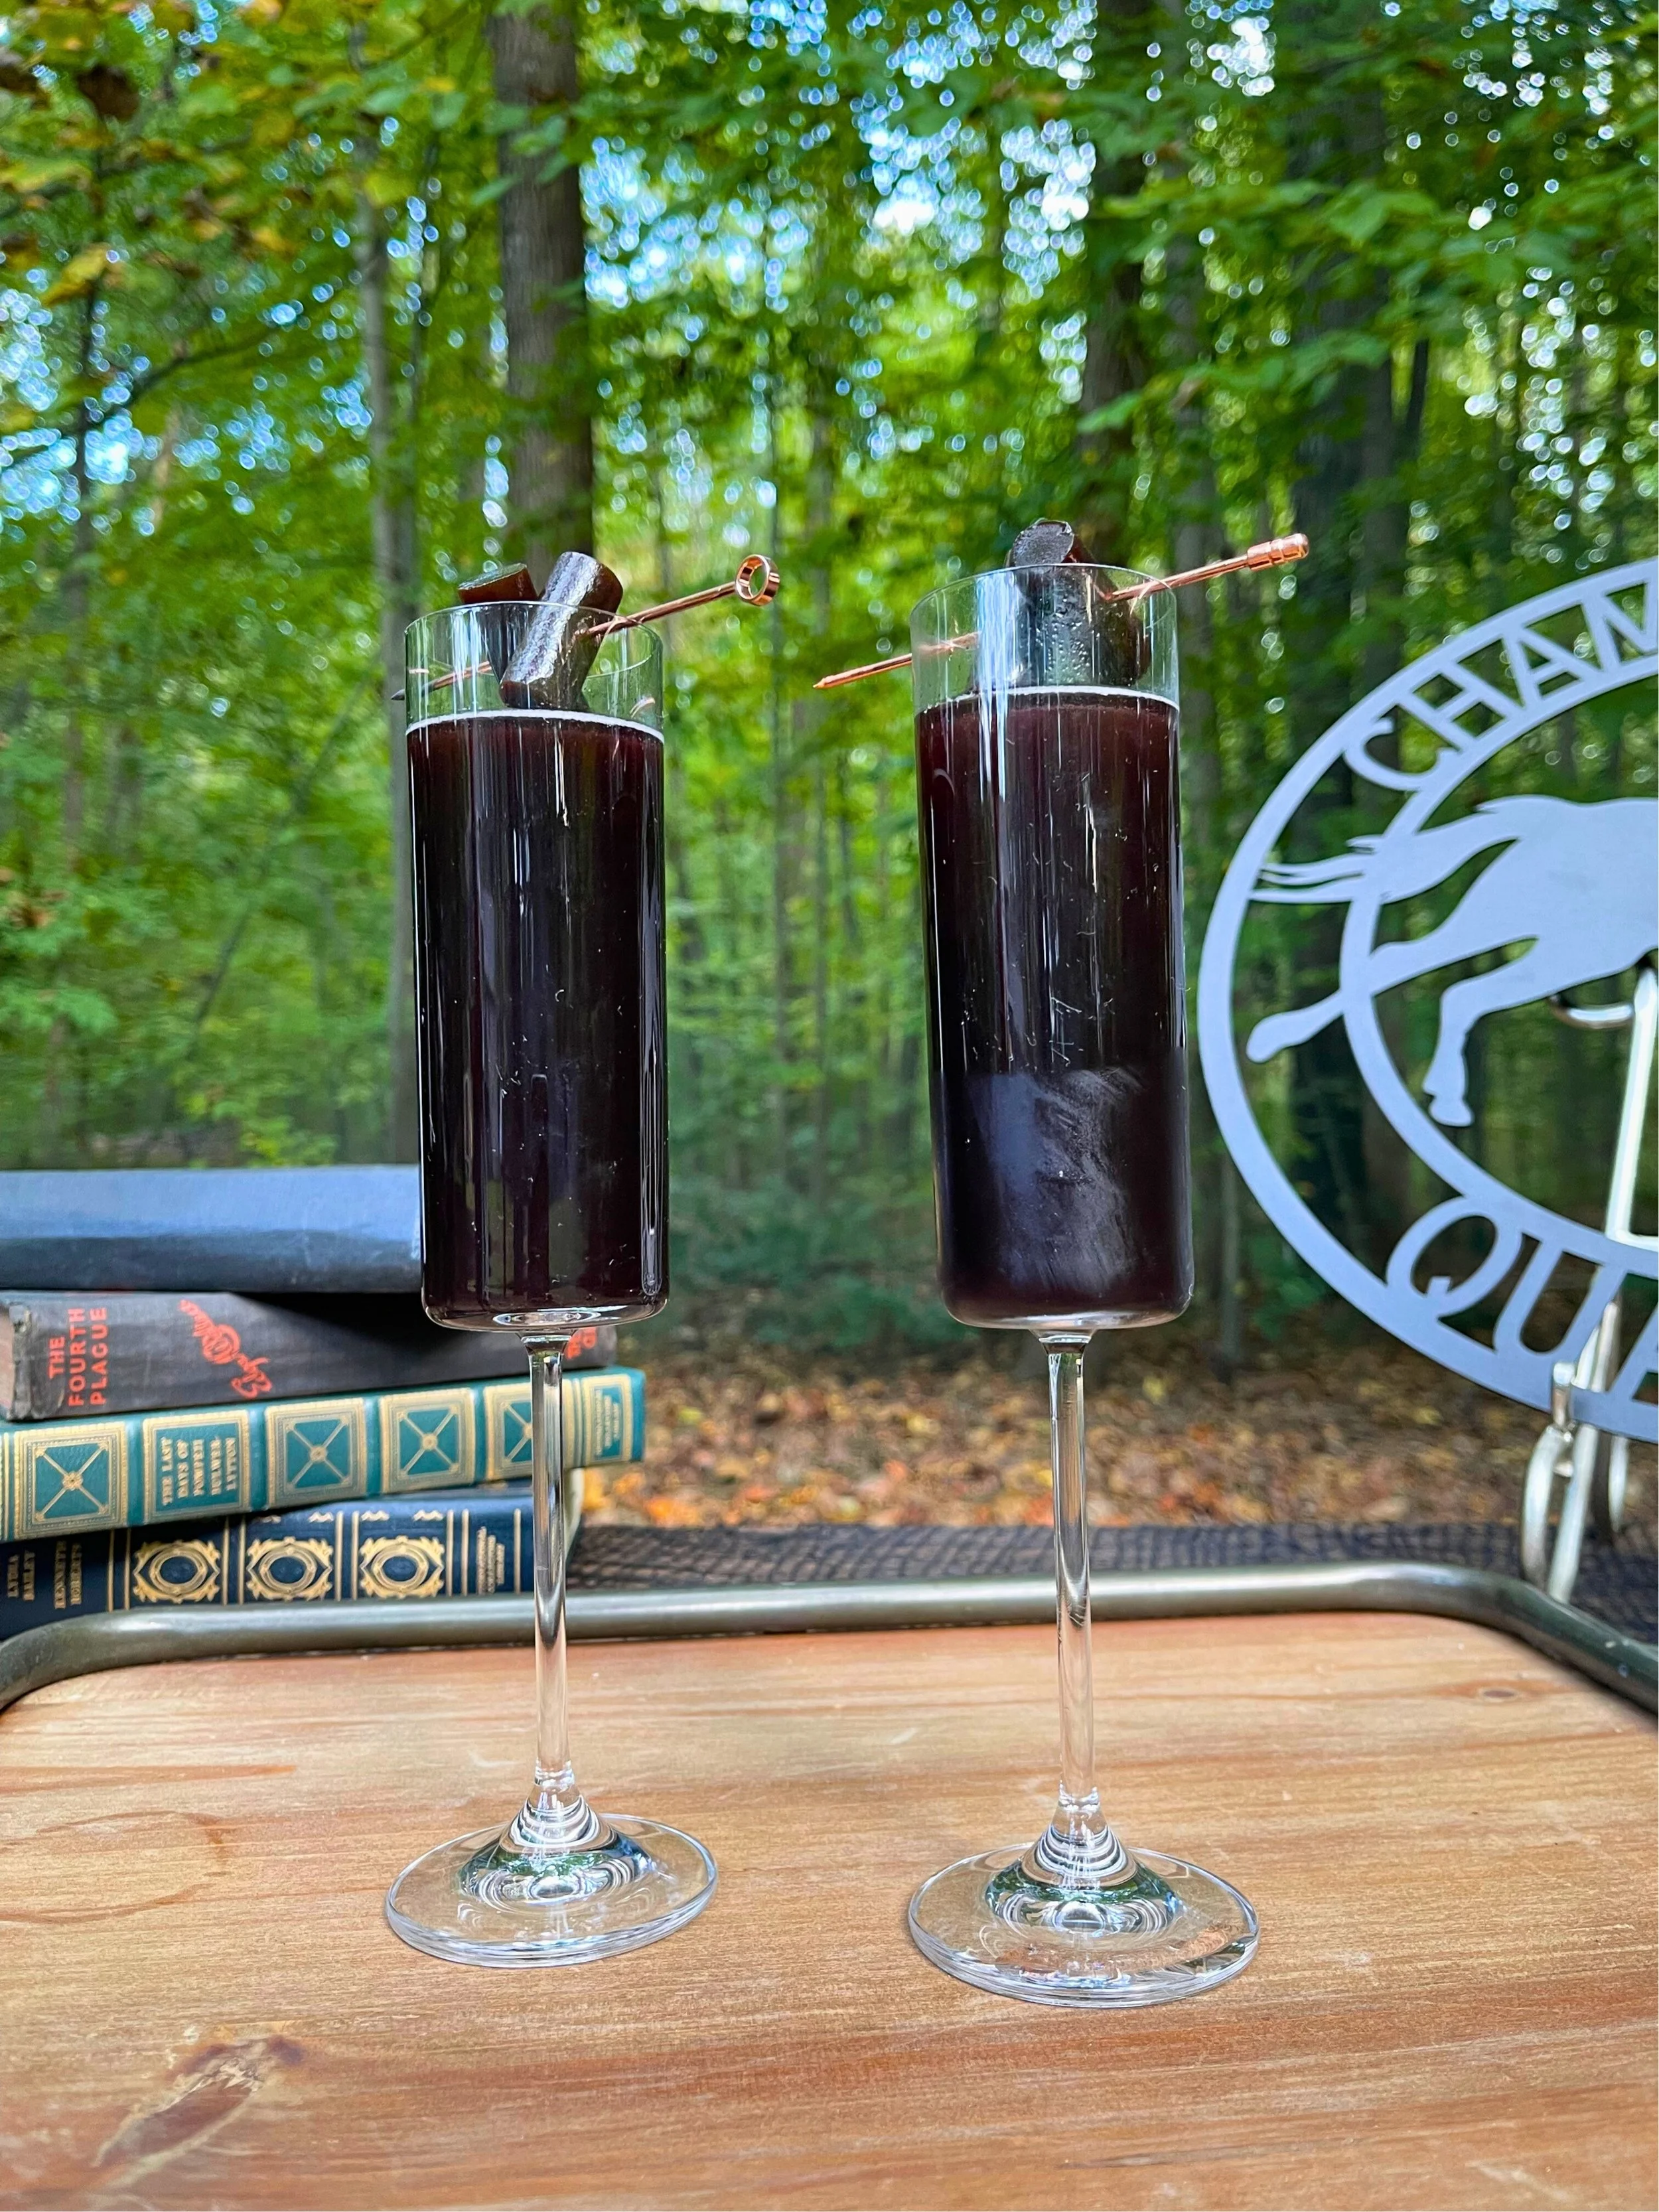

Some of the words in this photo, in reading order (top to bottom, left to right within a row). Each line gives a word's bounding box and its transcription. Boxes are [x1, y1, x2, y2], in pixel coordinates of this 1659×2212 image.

[49, 1335, 65, 1379] THE
[68, 1307, 86, 1406] FOURTH
[90, 1307, 108, 1406] PLAGUE
[161, 1437, 172, 1471] LAST
[162, 1476, 173, 1505] THE
[178, 1462, 188, 1498] DAYS
